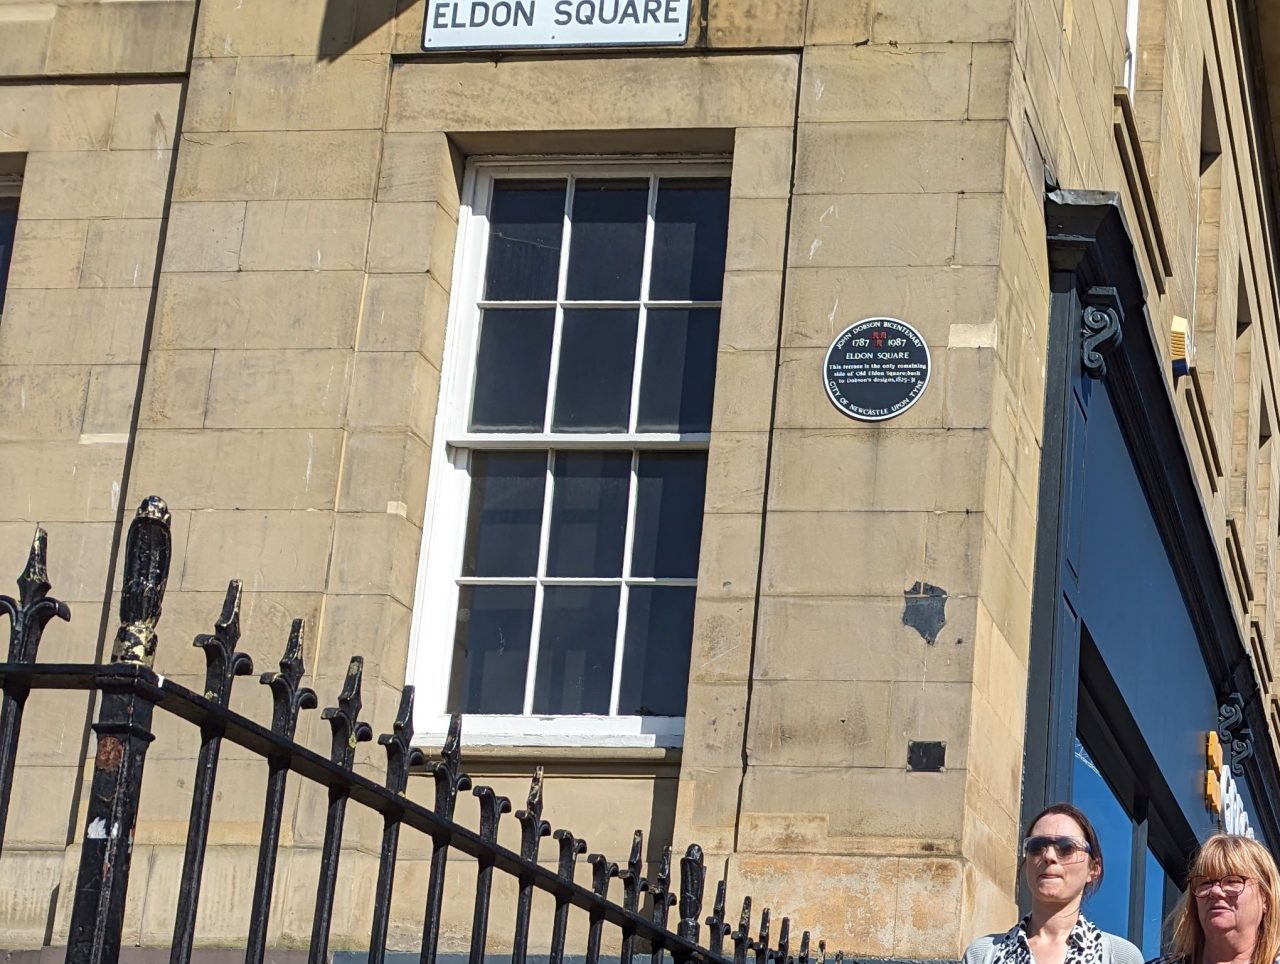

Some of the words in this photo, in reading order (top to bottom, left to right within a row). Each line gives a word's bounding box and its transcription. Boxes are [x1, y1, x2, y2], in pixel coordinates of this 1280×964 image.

[433, 1, 534, 28] ELDON
[554, 0, 680, 25] SQUARE
[836, 332, 851, 349] JOHN
[853, 322, 881, 335] DOBSON
[884, 322, 922, 347] BICENTENARY
[852, 338, 870, 347] 1787
[888, 338, 907, 347] 1987
[846, 352, 873, 360] ELDON
[877, 352, 909, 360] SQUARE
[829, 381, 841, 396] CITY
[850, 404, 888, 415] NEWCASTLE
[891, 398, 910, 411] UPON
[910, 380, 924, 397] TYNE
